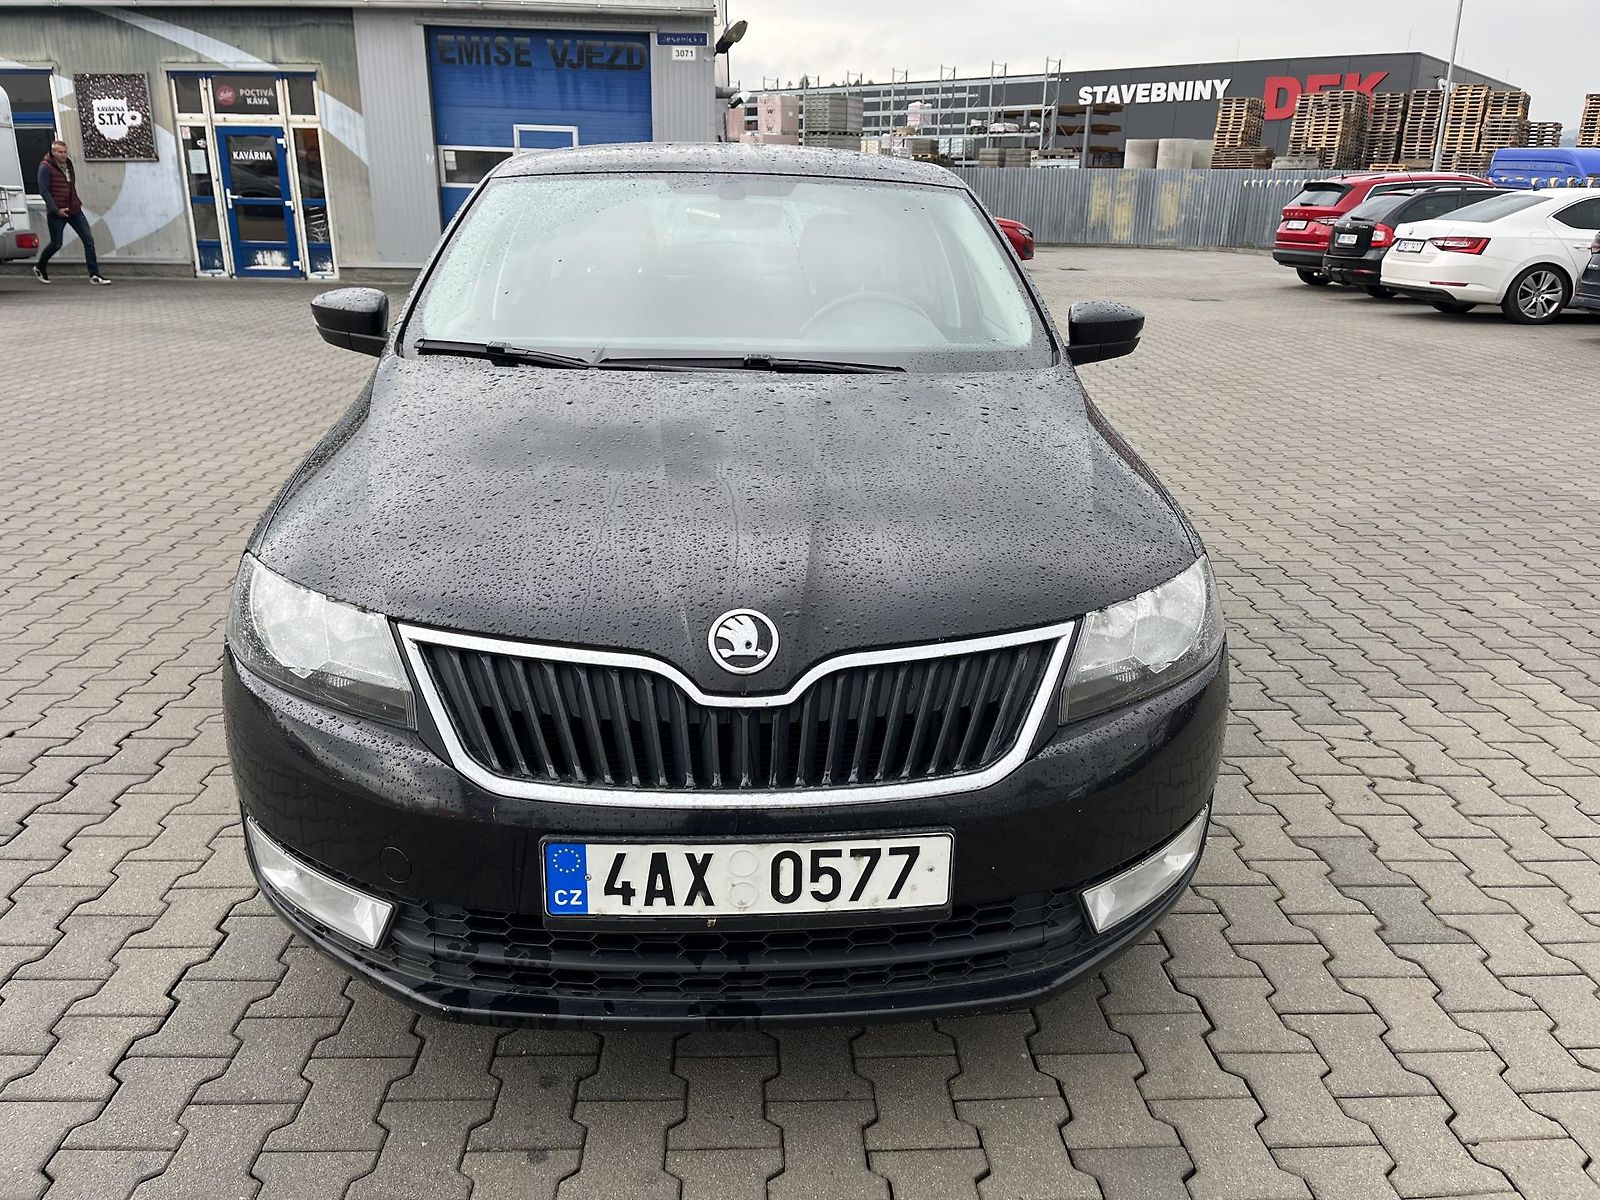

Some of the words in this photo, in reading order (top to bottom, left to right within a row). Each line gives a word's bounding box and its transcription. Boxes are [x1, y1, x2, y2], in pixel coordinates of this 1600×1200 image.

[437, 35, 532, 67] EMISE
[546, 39, 647, 71] VJEZD
[675, 49, 694, 58] 3071
[239, 87, 274, 97] POCTIVÁ
[1078, 78, 1231, 106] STAVEBNINY
[246, 96, 269, 105] KÁVA
[232, 149, 273, 161] KAVÁRNA
[603, 852, 715, 907] 4AX
[770, 845, 921, 904] 0577
[554, 888, 583, 906] CZ
